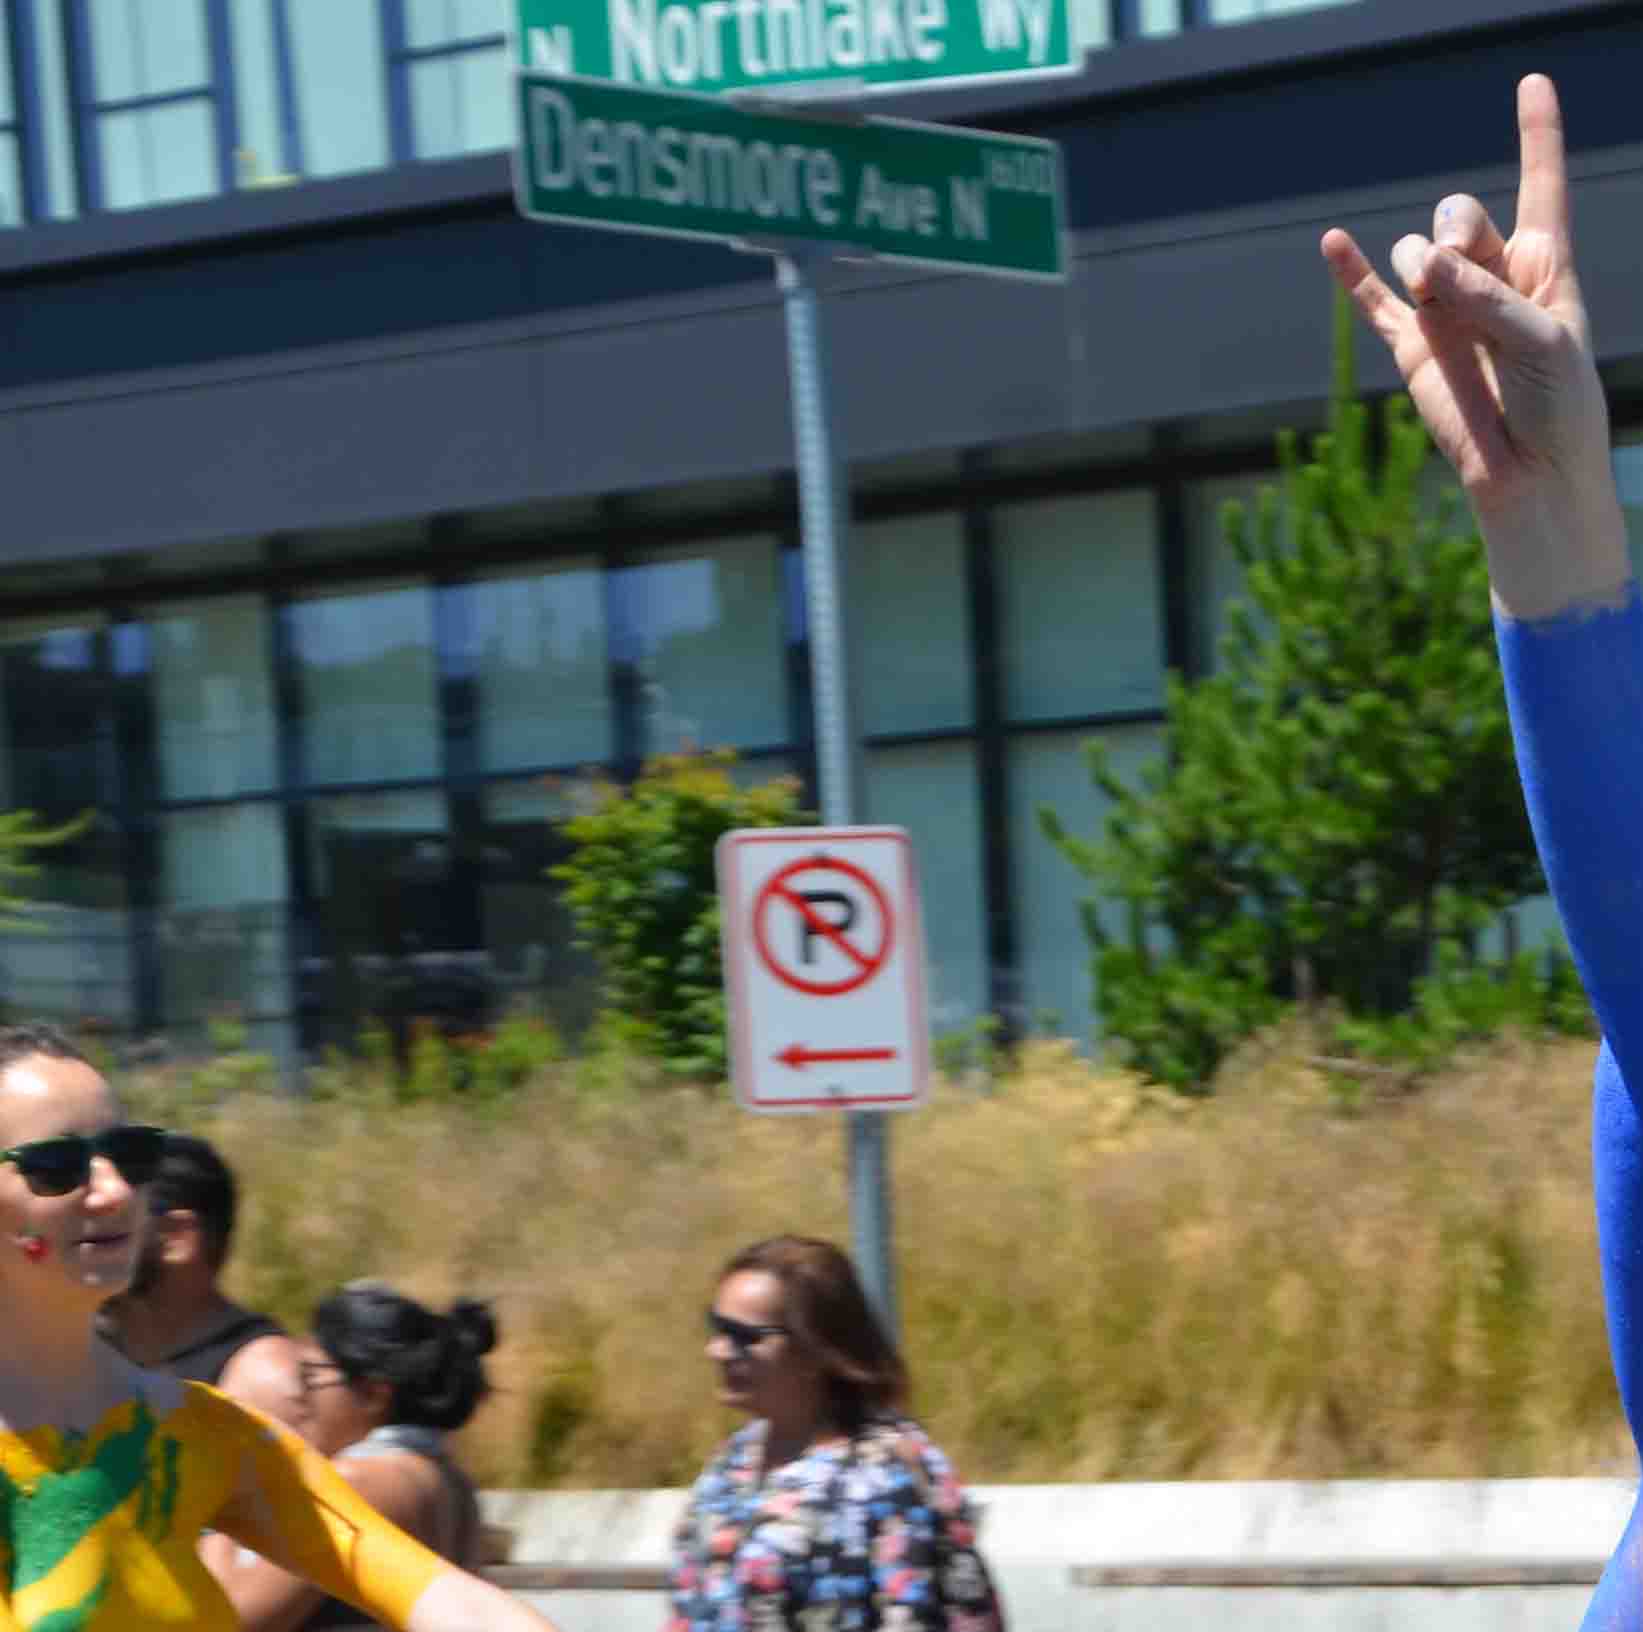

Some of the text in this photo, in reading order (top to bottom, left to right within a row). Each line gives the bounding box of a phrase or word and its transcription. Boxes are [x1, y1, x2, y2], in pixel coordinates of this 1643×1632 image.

[528, 0, 1049, 84] N Northlake Wy
[528, 86, 840, 227] Densmore
[855, 162, 938, 238] Ave
[948, 174, 990, 242] N
